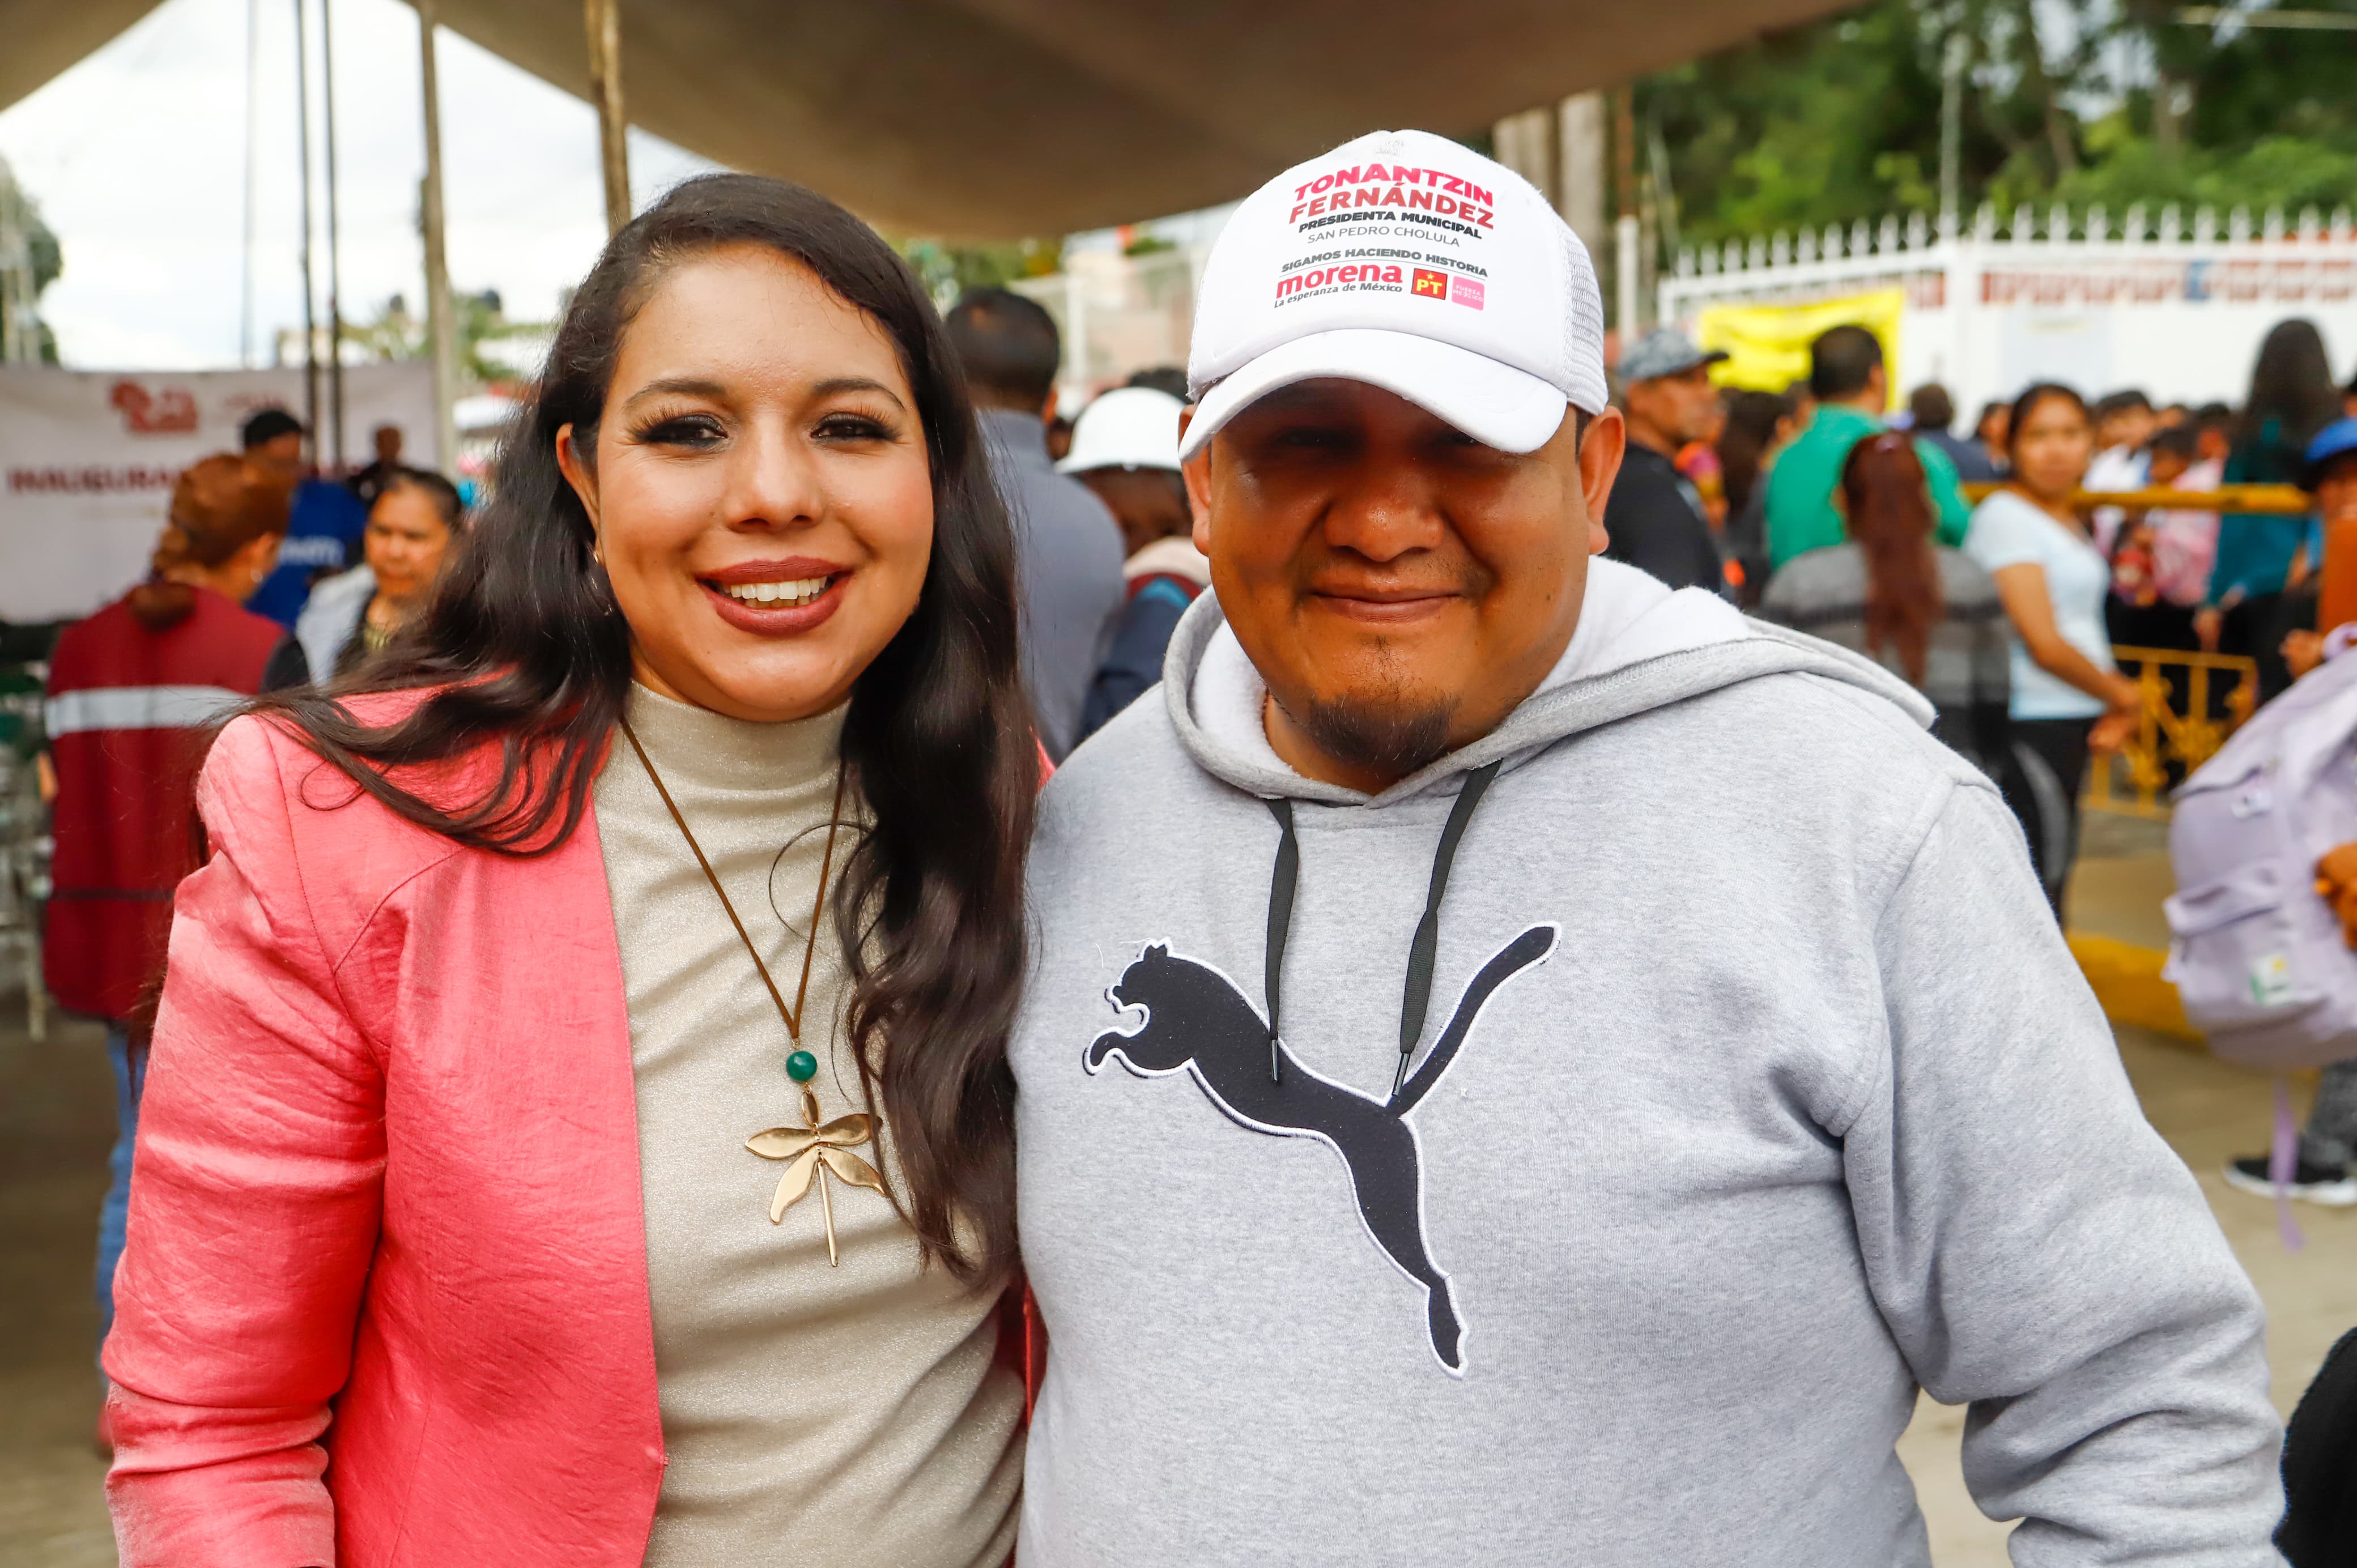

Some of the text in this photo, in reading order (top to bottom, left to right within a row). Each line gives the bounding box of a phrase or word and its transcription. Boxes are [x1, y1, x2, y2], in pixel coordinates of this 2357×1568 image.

[1295, 164, 1493, 207] TONANTZIN
[1289, 182, 1494, 229] FERNÁNDEZ
[1299, 211, 1482, 239] PRESIDENTA MUNICIPAL
[1307, 226, 1460, 247] SAN PEDRO CHOLULA
[1282, 249, 1488, 277] SIGAMOS HACIENDO HISTORIA
[1274, 300, 1284, 308] La
[1287, 286, 1339, 304] esperanza
[1360, 283, 1403, 292] México
[1276, 265, 1403, 299] morena
[1416, 279, 1443, 295] PT
[1456, 285, 1481, 296] FUERZA
